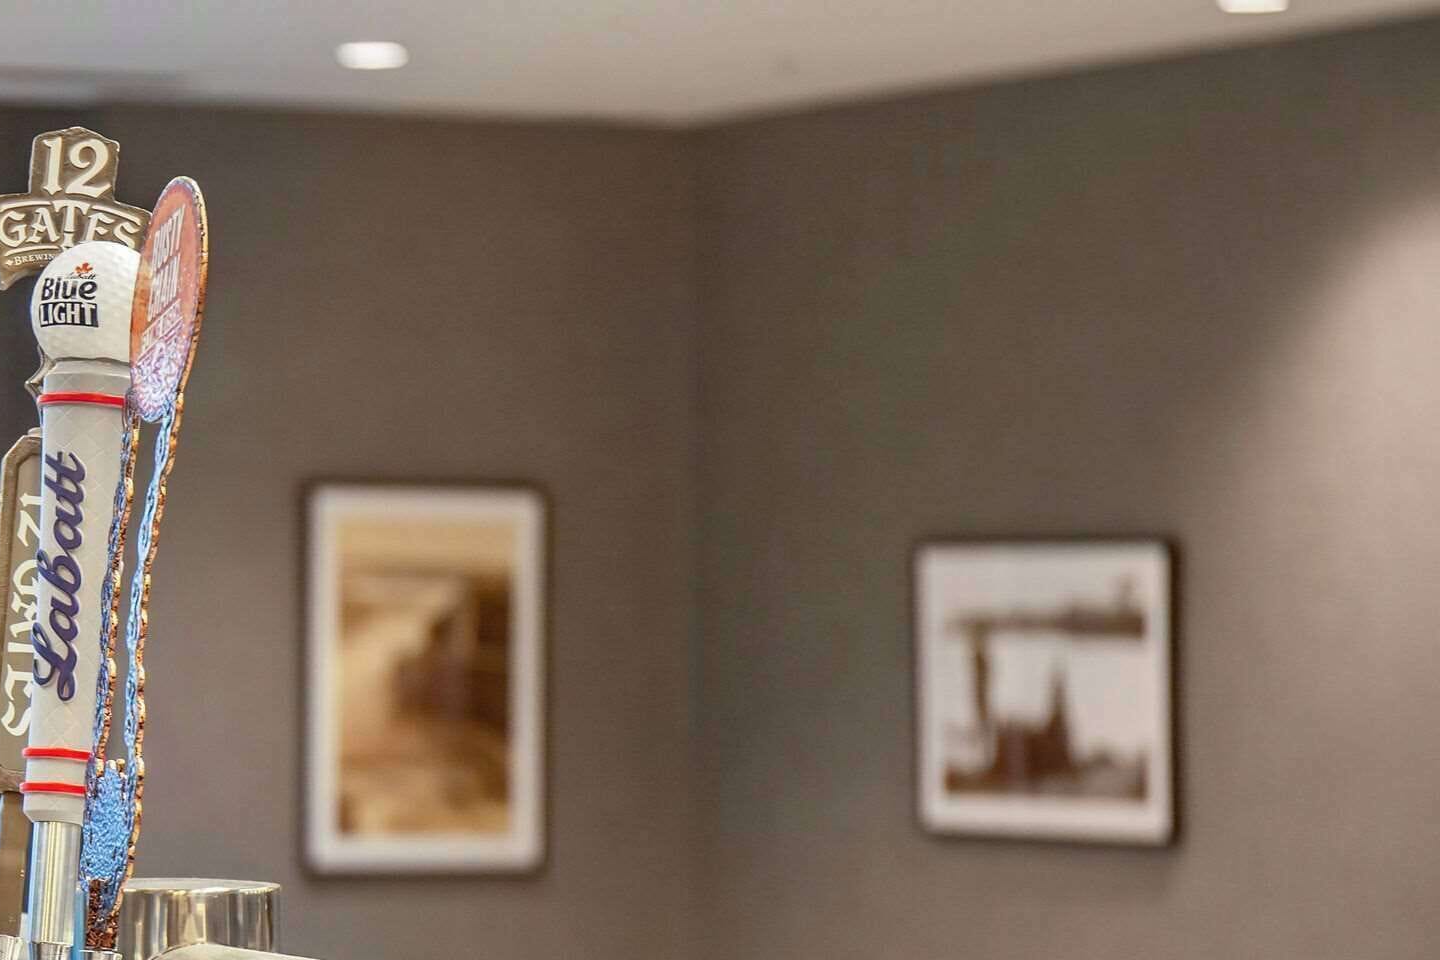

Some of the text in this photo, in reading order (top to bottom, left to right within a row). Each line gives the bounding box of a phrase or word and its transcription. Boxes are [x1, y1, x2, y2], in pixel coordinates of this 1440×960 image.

[42, 136, 111, 198] 12
[14, 253, 56, 266] BREWIN
[41, 277, 98, 301] Blue
[39, 302, 97, 326] LIGHT
[32, 451, 86, 701] Labatt
